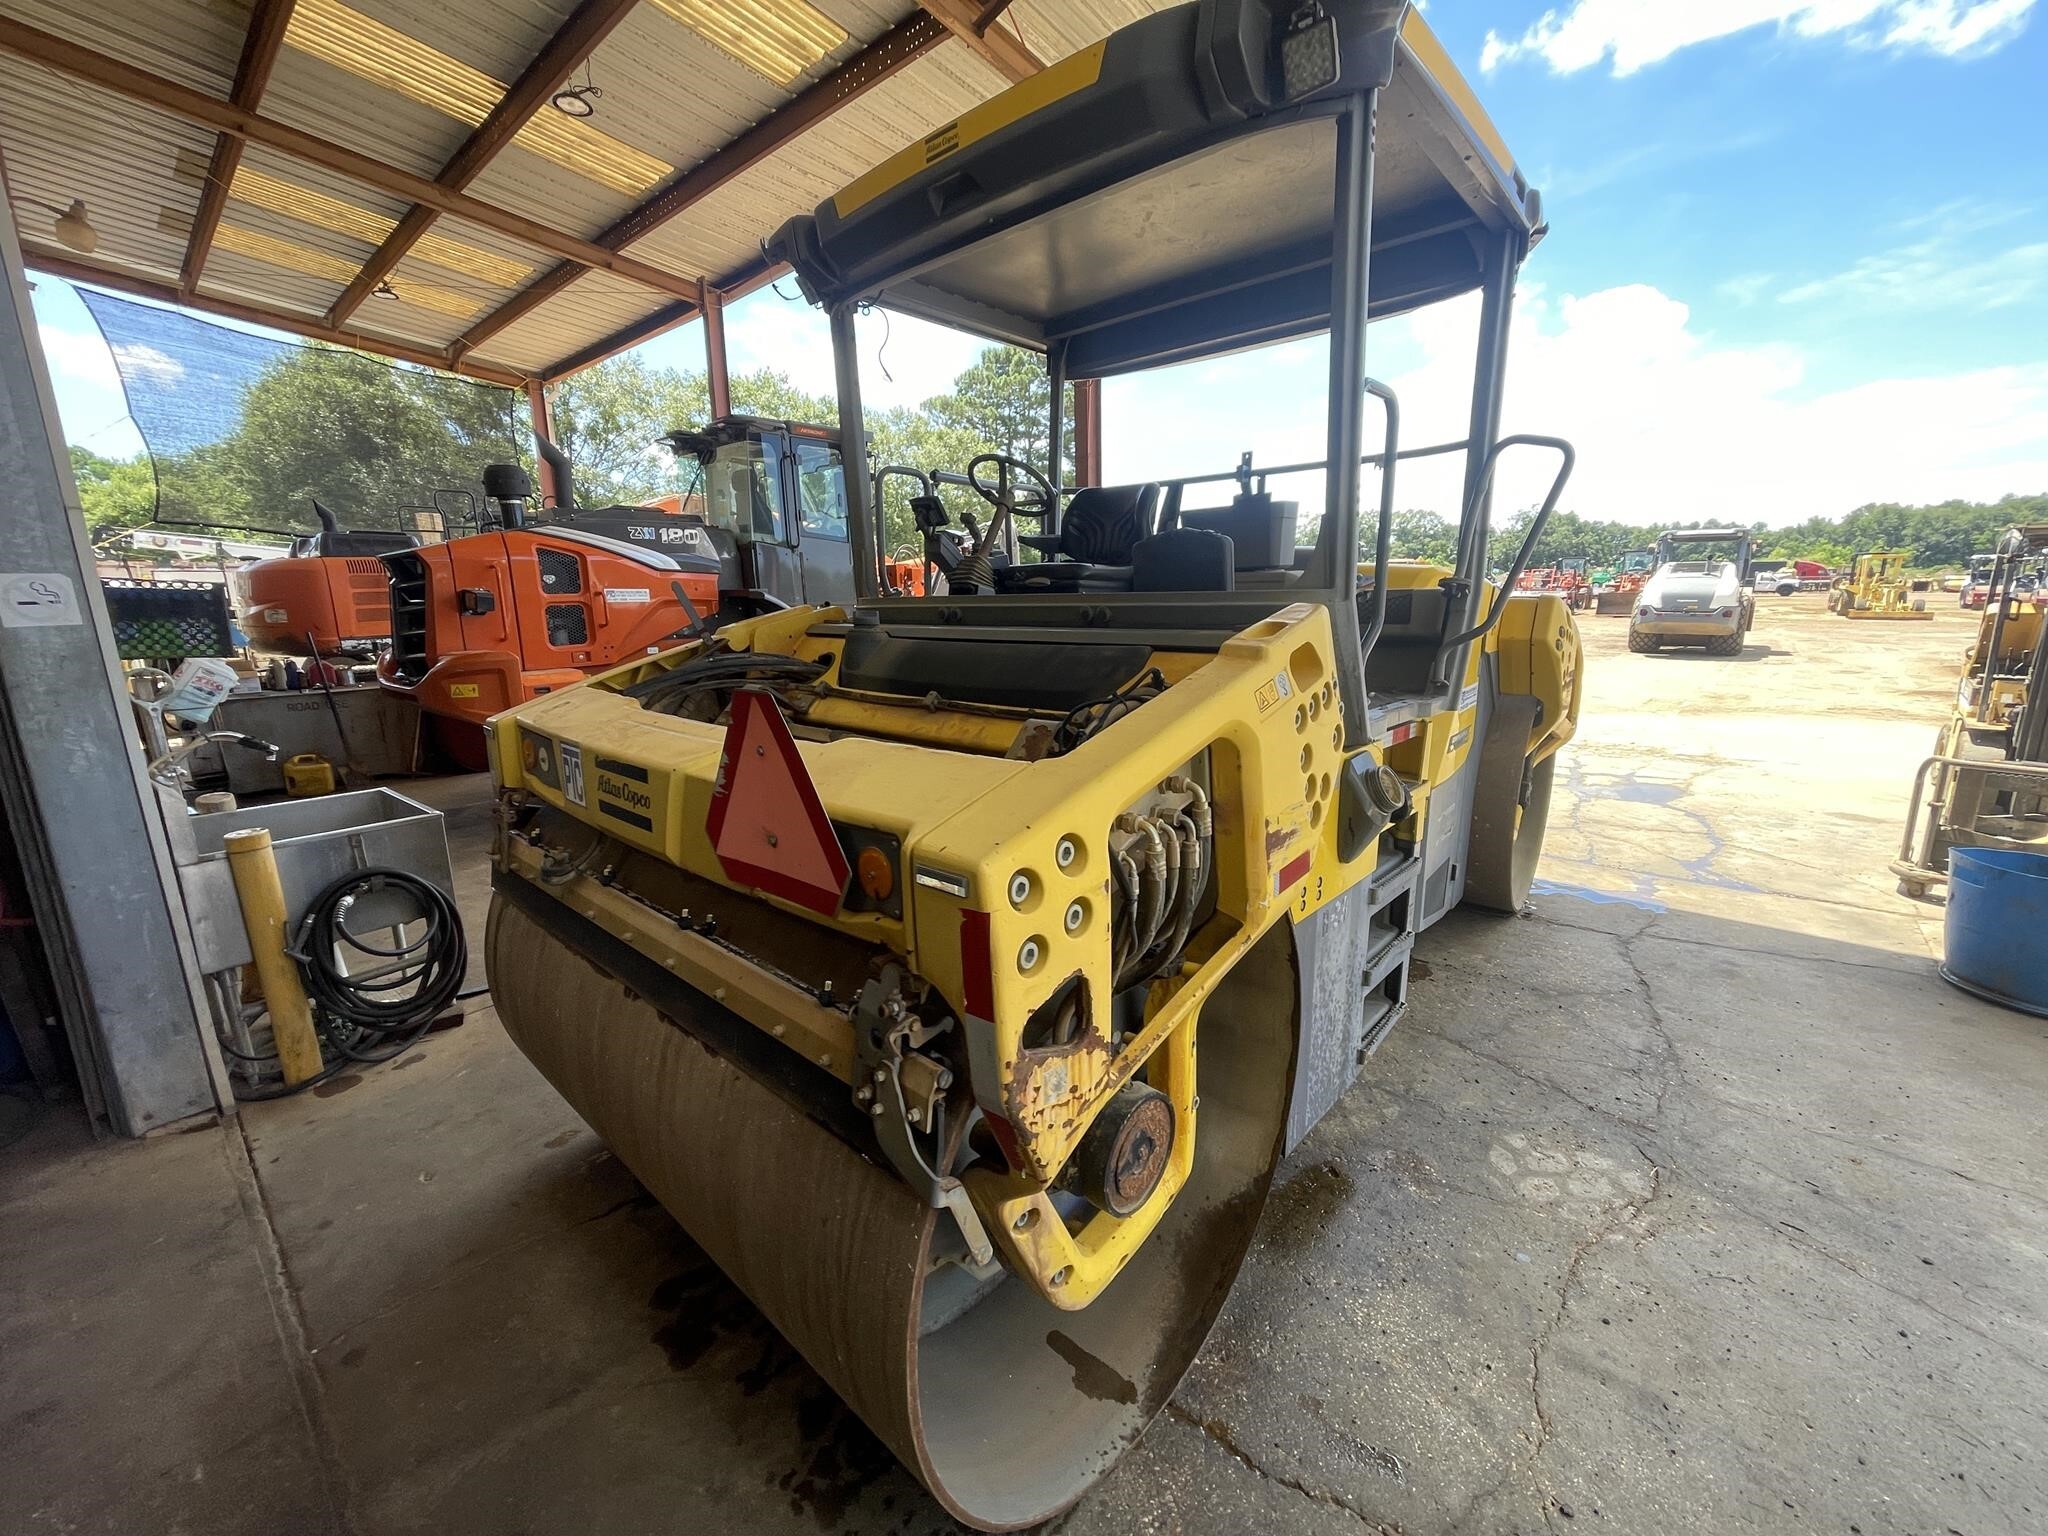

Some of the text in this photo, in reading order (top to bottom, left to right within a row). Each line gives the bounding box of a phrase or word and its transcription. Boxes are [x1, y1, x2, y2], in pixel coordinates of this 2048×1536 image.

[659, 527, 700, 545] 180
[287, 701, 320, 712] ROAD
[597, 774, 651, 810] Atlas Copco
